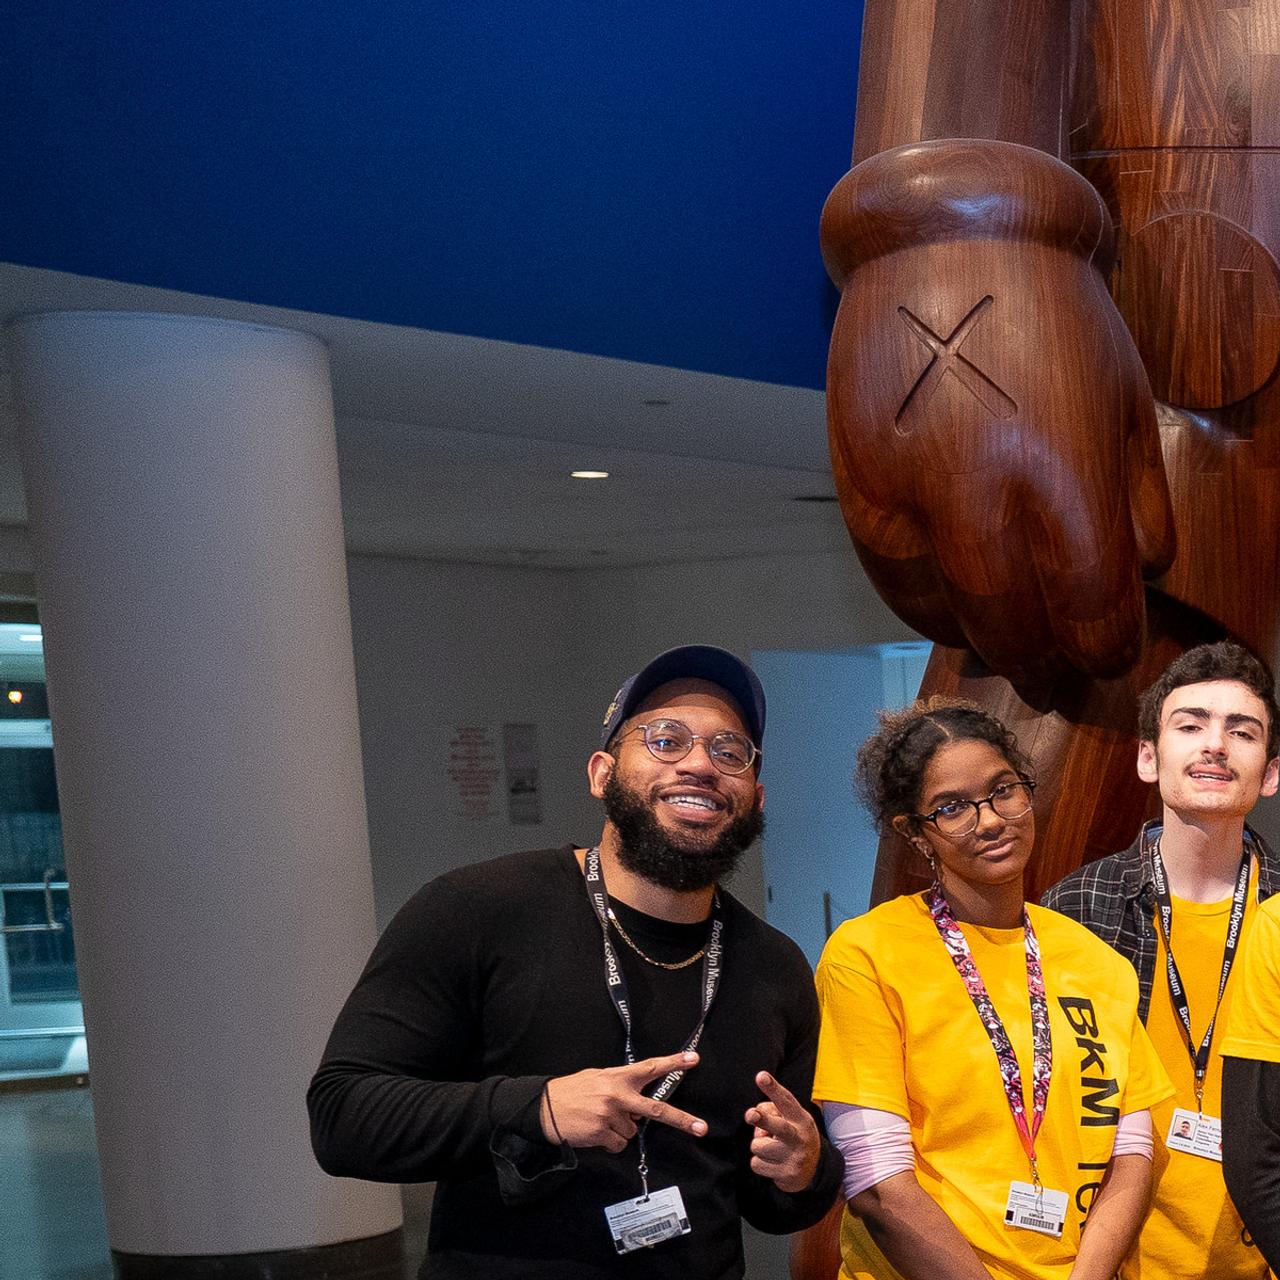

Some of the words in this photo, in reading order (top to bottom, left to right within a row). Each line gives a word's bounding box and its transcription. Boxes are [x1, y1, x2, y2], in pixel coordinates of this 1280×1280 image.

[1154, 855, 1166, 895] Museum
[1233, 863, 1249, 902] Museum
[707, 919, 724, 967] Brooklyn
[1226, 899, 1243, 949] Brooklyn
[1057, 996, 1121, 1128] BkM
[653, 1070, 684, 1101] Museu
